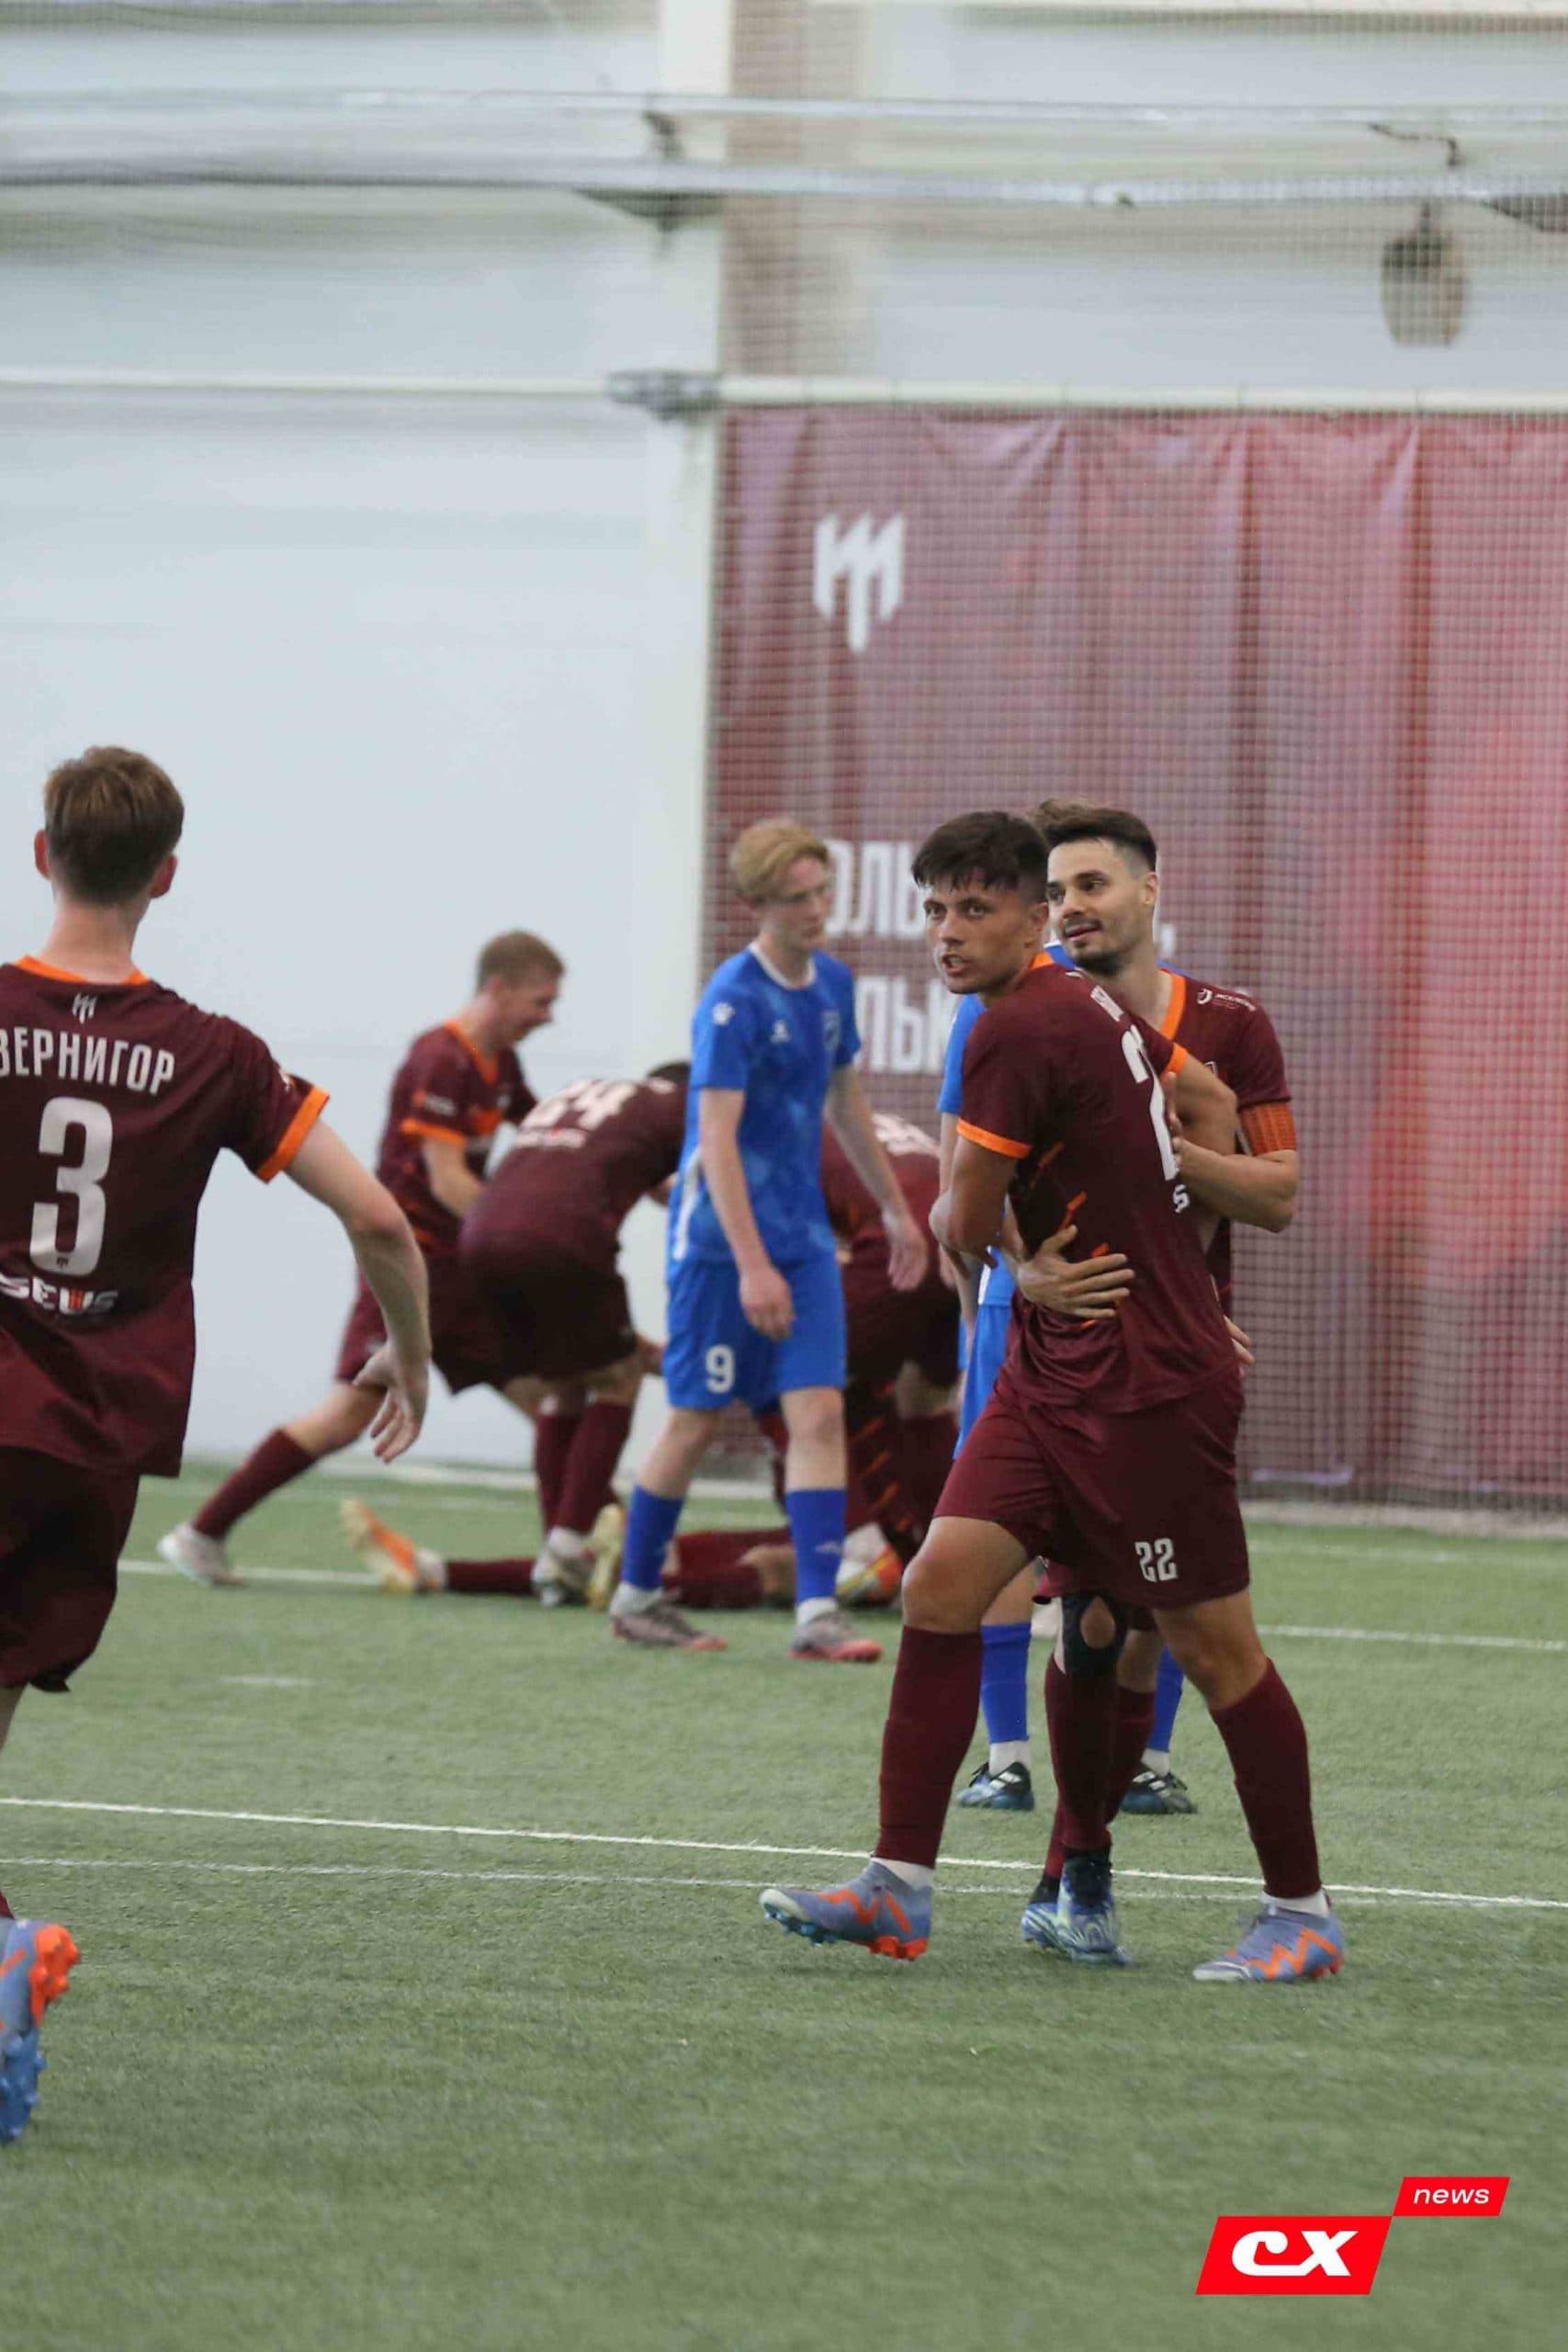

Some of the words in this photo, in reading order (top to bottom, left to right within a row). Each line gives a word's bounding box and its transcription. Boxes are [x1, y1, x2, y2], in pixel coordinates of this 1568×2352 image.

[29, 1097, 113, 1276] 3
[705, 1345, 735, 1394] 9
[1134, 1538, 1178, 1583] 22
